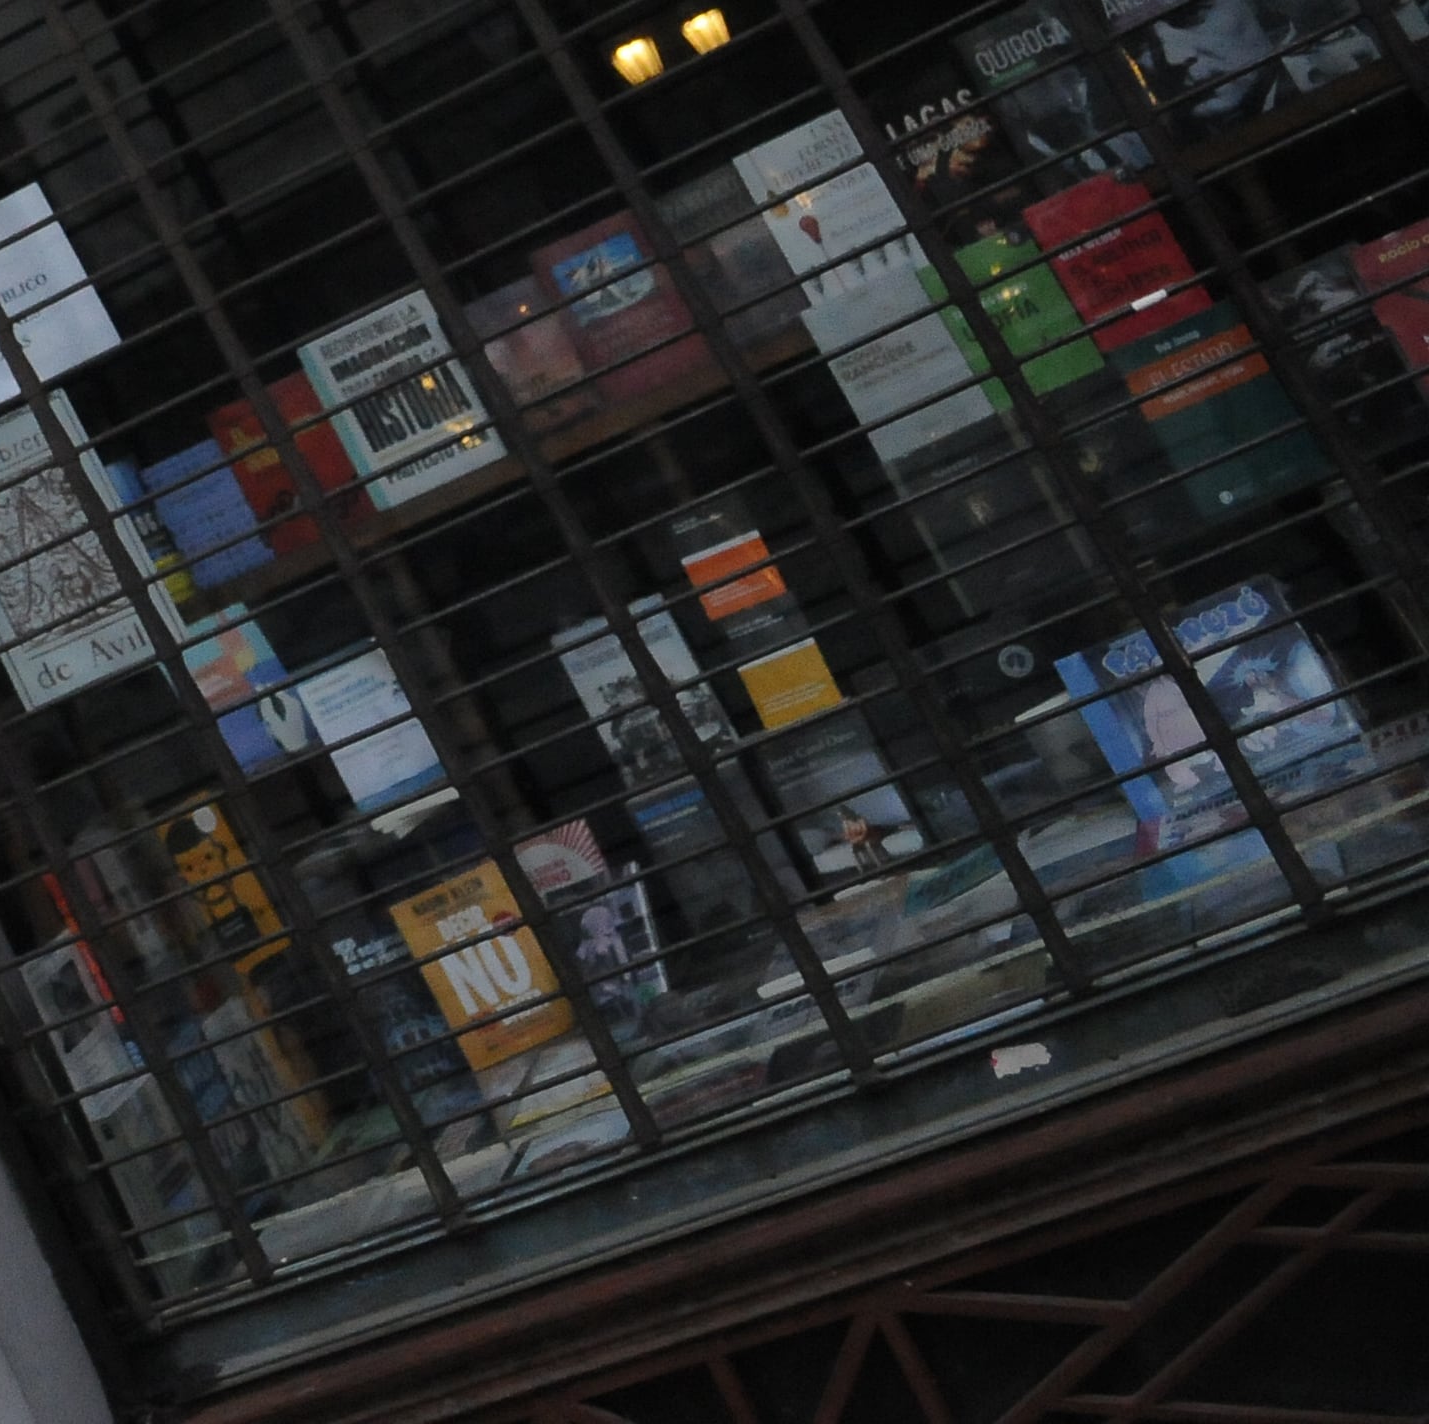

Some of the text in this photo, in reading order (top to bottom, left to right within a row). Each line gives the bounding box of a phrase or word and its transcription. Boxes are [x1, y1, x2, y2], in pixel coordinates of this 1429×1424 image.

[972, 12, 1073, 80] QUIROGA
[32, 619, 150, 692] de Avil
